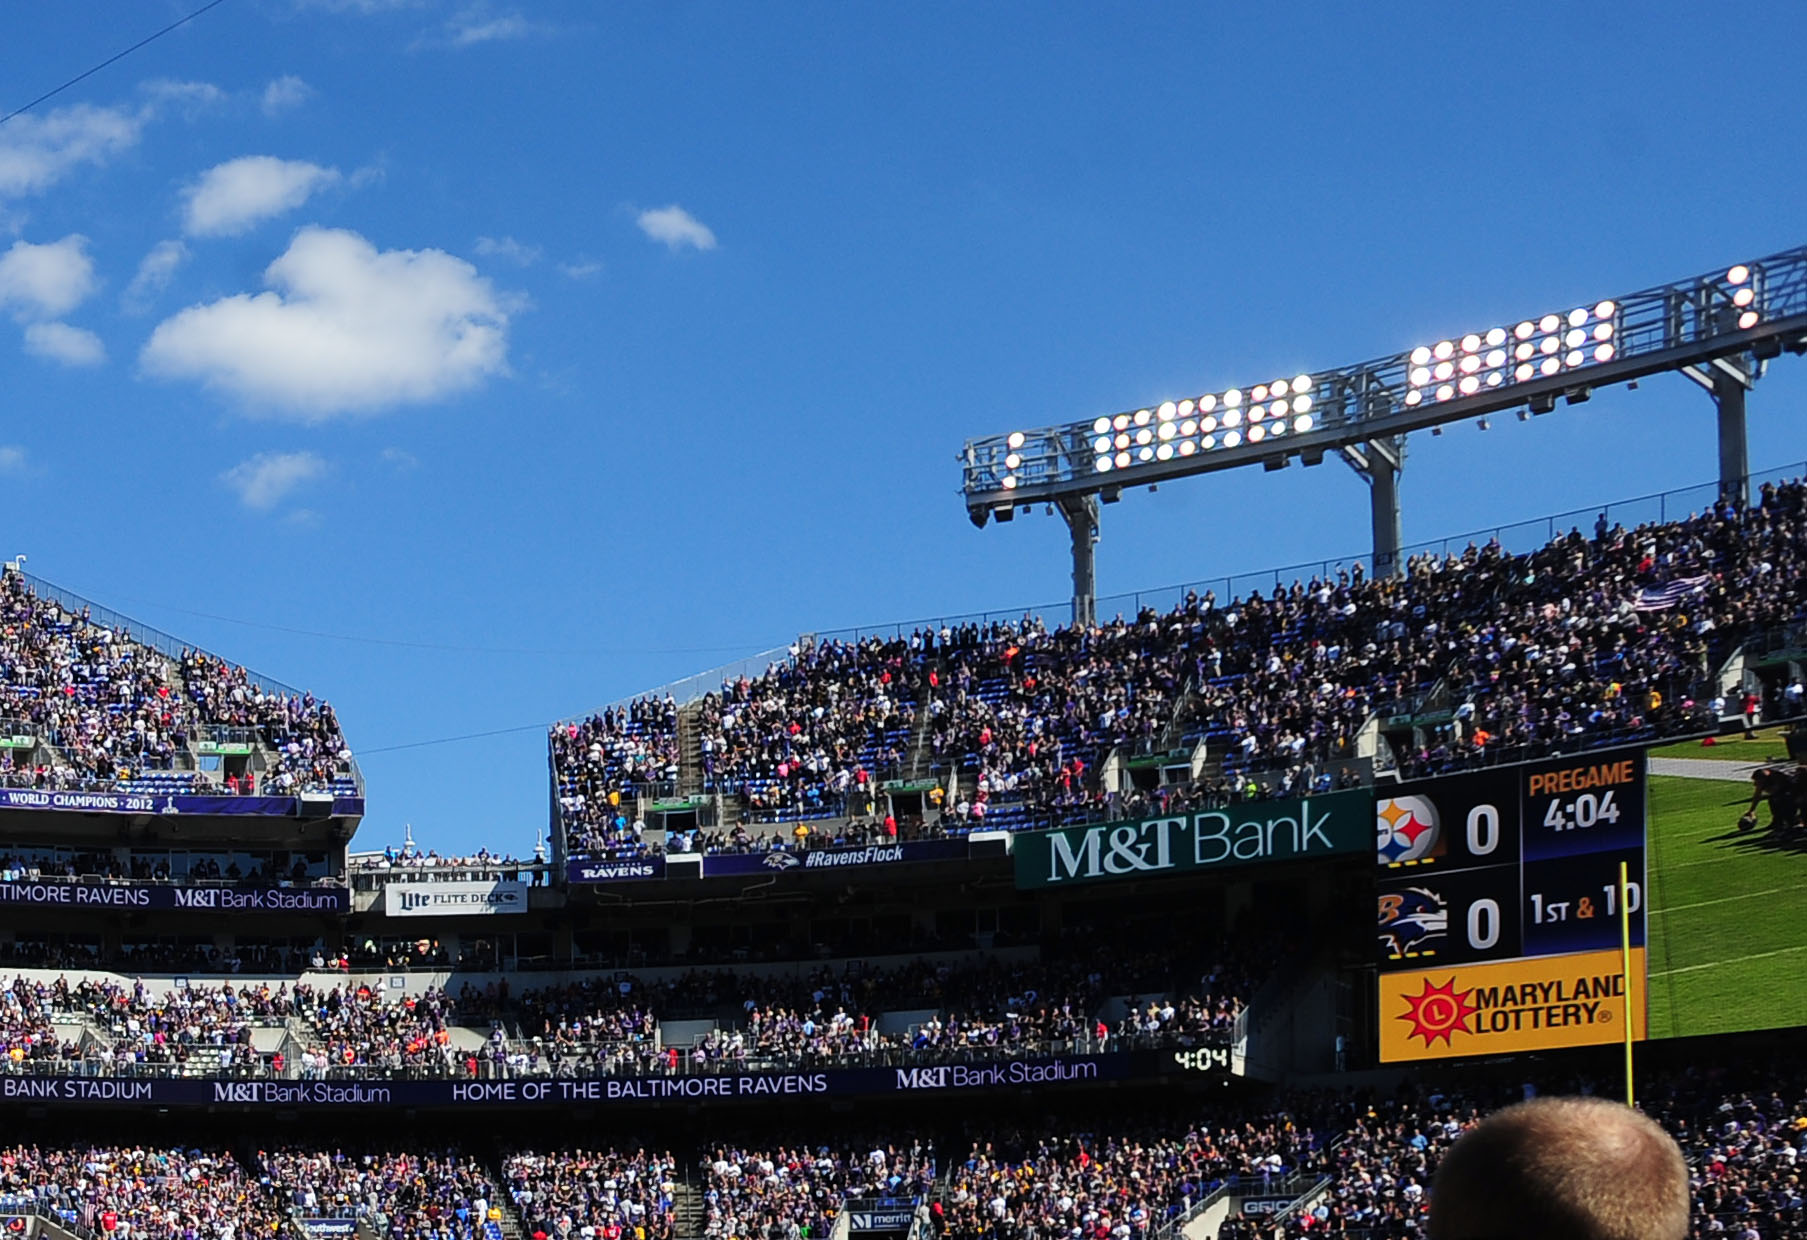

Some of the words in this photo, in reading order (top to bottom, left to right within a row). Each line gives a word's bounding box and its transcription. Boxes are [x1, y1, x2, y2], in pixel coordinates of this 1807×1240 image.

[1529, 760, 1634, 797] PREGAME
[9, 792, 49, 806] WORLD
[53, 794, 119, 809] CHAMPIONS
[126, 798, 153, 810] 2012
[1543, 790, 1620, 832] 4:04
[1046, 816, 1186, 882] M&T
[1194, 801, 1333, 865] Bank
[1466, 804, 1499, 856] 0
[806, 847, 903, 868] #RavensFlock
[580, 865, 654, 879] RAVENS
[79, 887, 150, 905] RAVENS
[174, 889, 220, 908] M&T
[221, 889, 263, 908] Bank
[266, 890, 338, 910] Stadium
[400, 893, 430, 910] Lite
[433, 894, 467, 904] FLITE
[471, 894, 503, 903] DECK
[1530, 894, 1570, 924] 1ST
[1576, 897, 1594, 918] &
[1603, 882, 1641, 917] 10
[1467, 898, 1500, 949] 0
[1474, 973, 1626, 1011] MARYLAND
[1174, 1048, 1228, 1071] 4:04
[895, 1065, 952, 1089] M&T
[954, 1064, 1004, 1087] Bank
[1009, 1061, 1096, 1085] Stadium
[4, 1078, 58, 1098] BANK
[64, 1080, 152, 1100] STADIUM
[214, 1082, 263, 1102] M&T
[264, 1082, 311, 1103] Bank
[314, 1083, 390, 1103] Stadium
[453, 1083, 516, 1101] HOME
[522, 1082, 552, 1100] OF
[561, 1081, 600, 1099] THE
[607, 1076, 733, 1098] BALTIMORE
[740, 1073, 828, 1095] RAVENS
[874, 1213, 912, 1223] merritt
